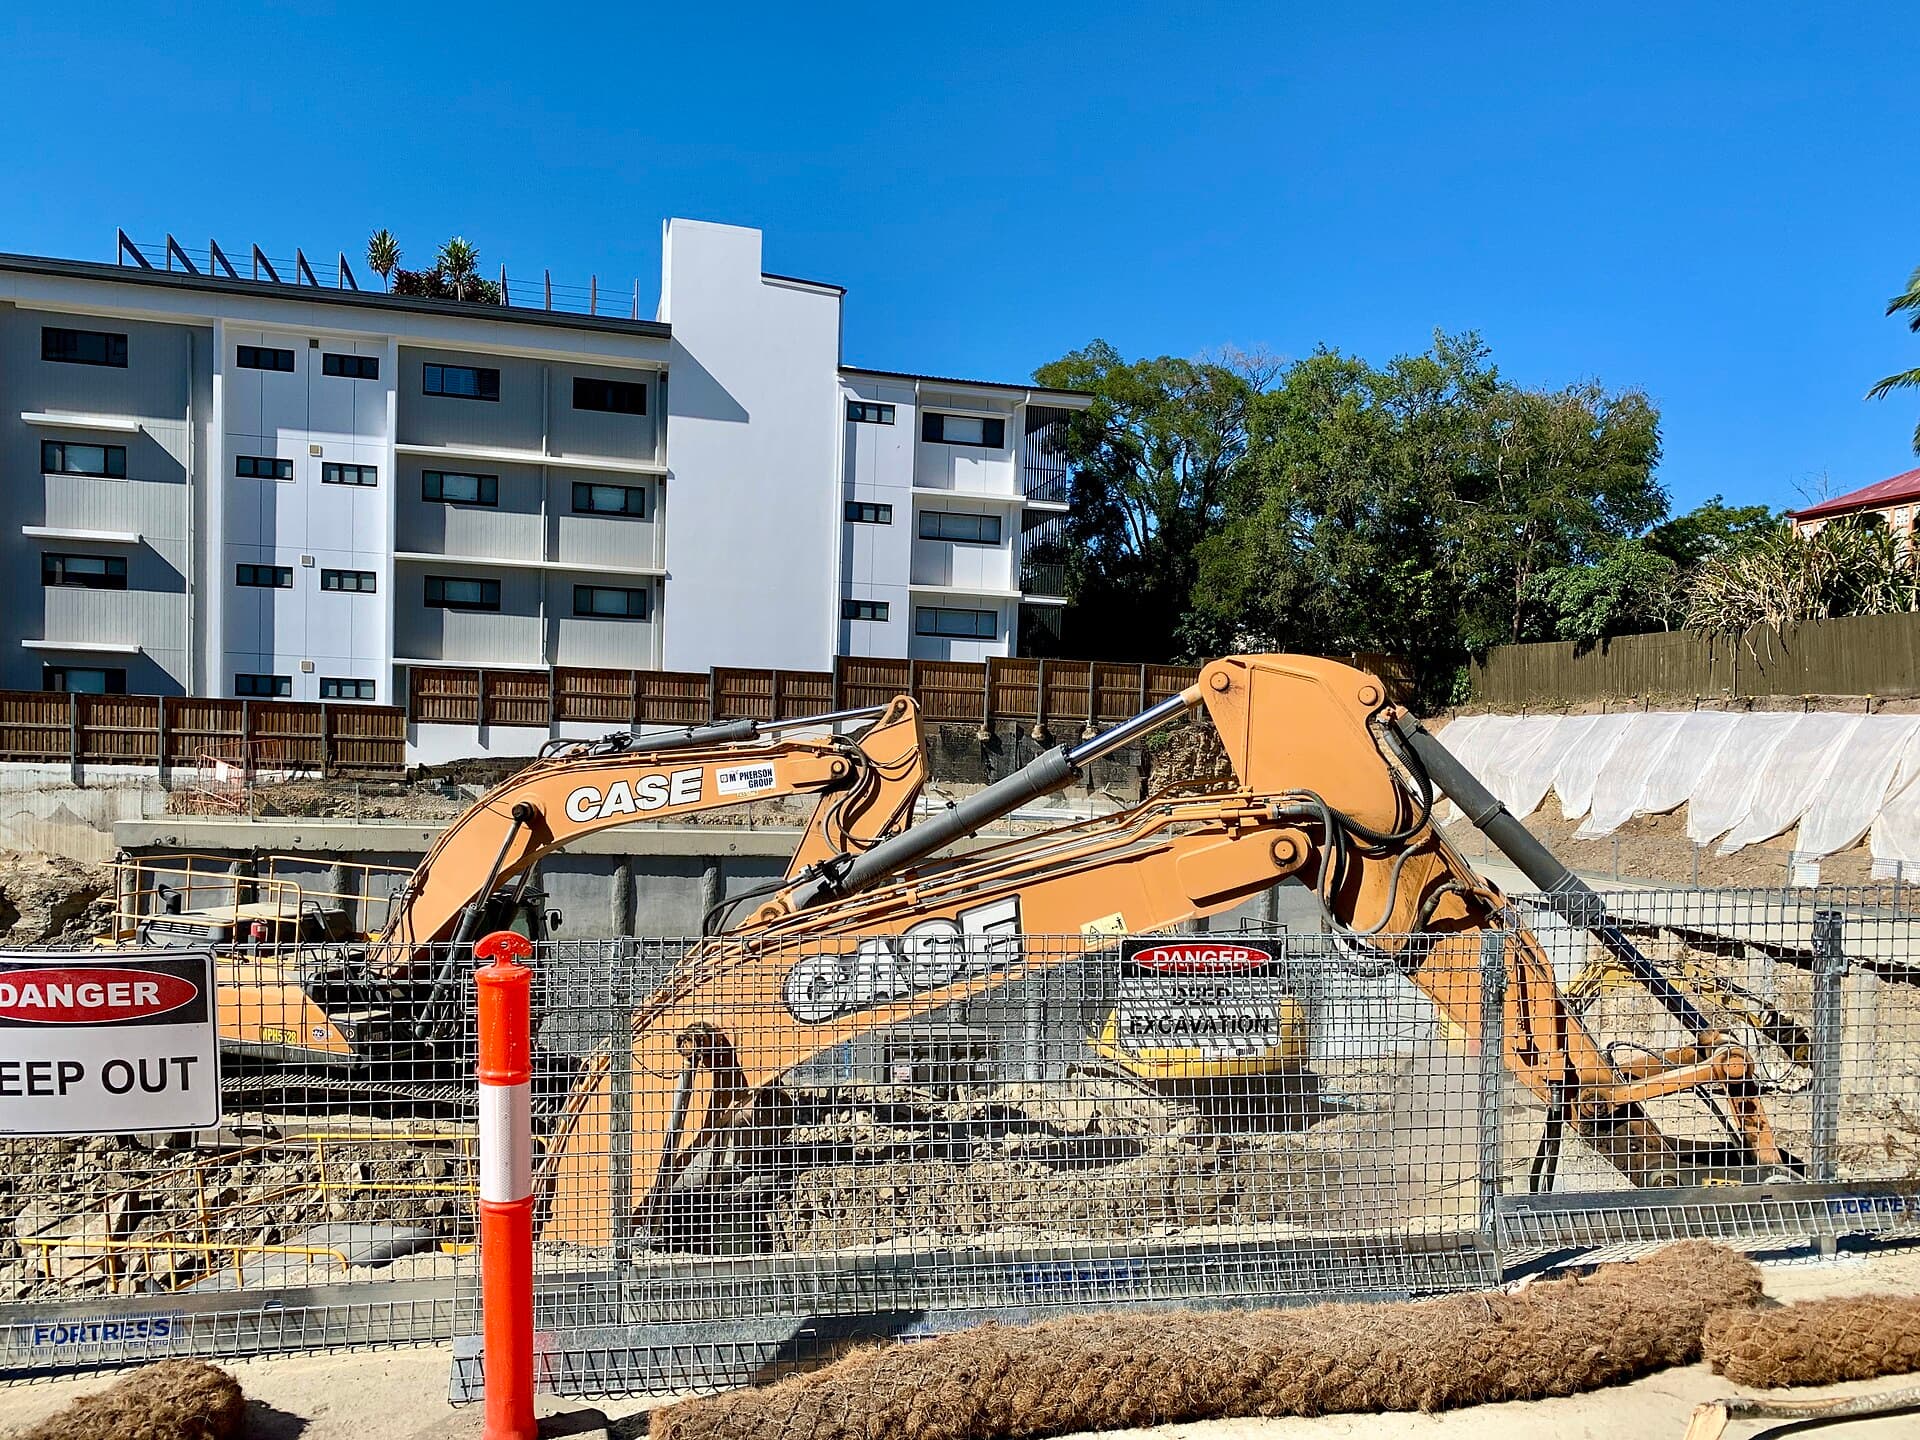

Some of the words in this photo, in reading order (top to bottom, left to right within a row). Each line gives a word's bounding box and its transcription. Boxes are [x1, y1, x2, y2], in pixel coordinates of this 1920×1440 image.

[565, 767, 703, 822] CASE
[748, 778, 773, 788] GROUP
[782, 894, 1023, 1025] CASE
[1153, 950, 1249, 967] DANGER
[0, 982, 161, 1008] DANGER
[1130, 1014, 1270, 1035] EXCAVATION
[0, 1061, 85, 1097] EEP
[101, 1056, 199, 1095] OUT
[1835, 1196, 1920, 1214] FORTRE
[34, 1318, 171, 1346] FORTRESS
